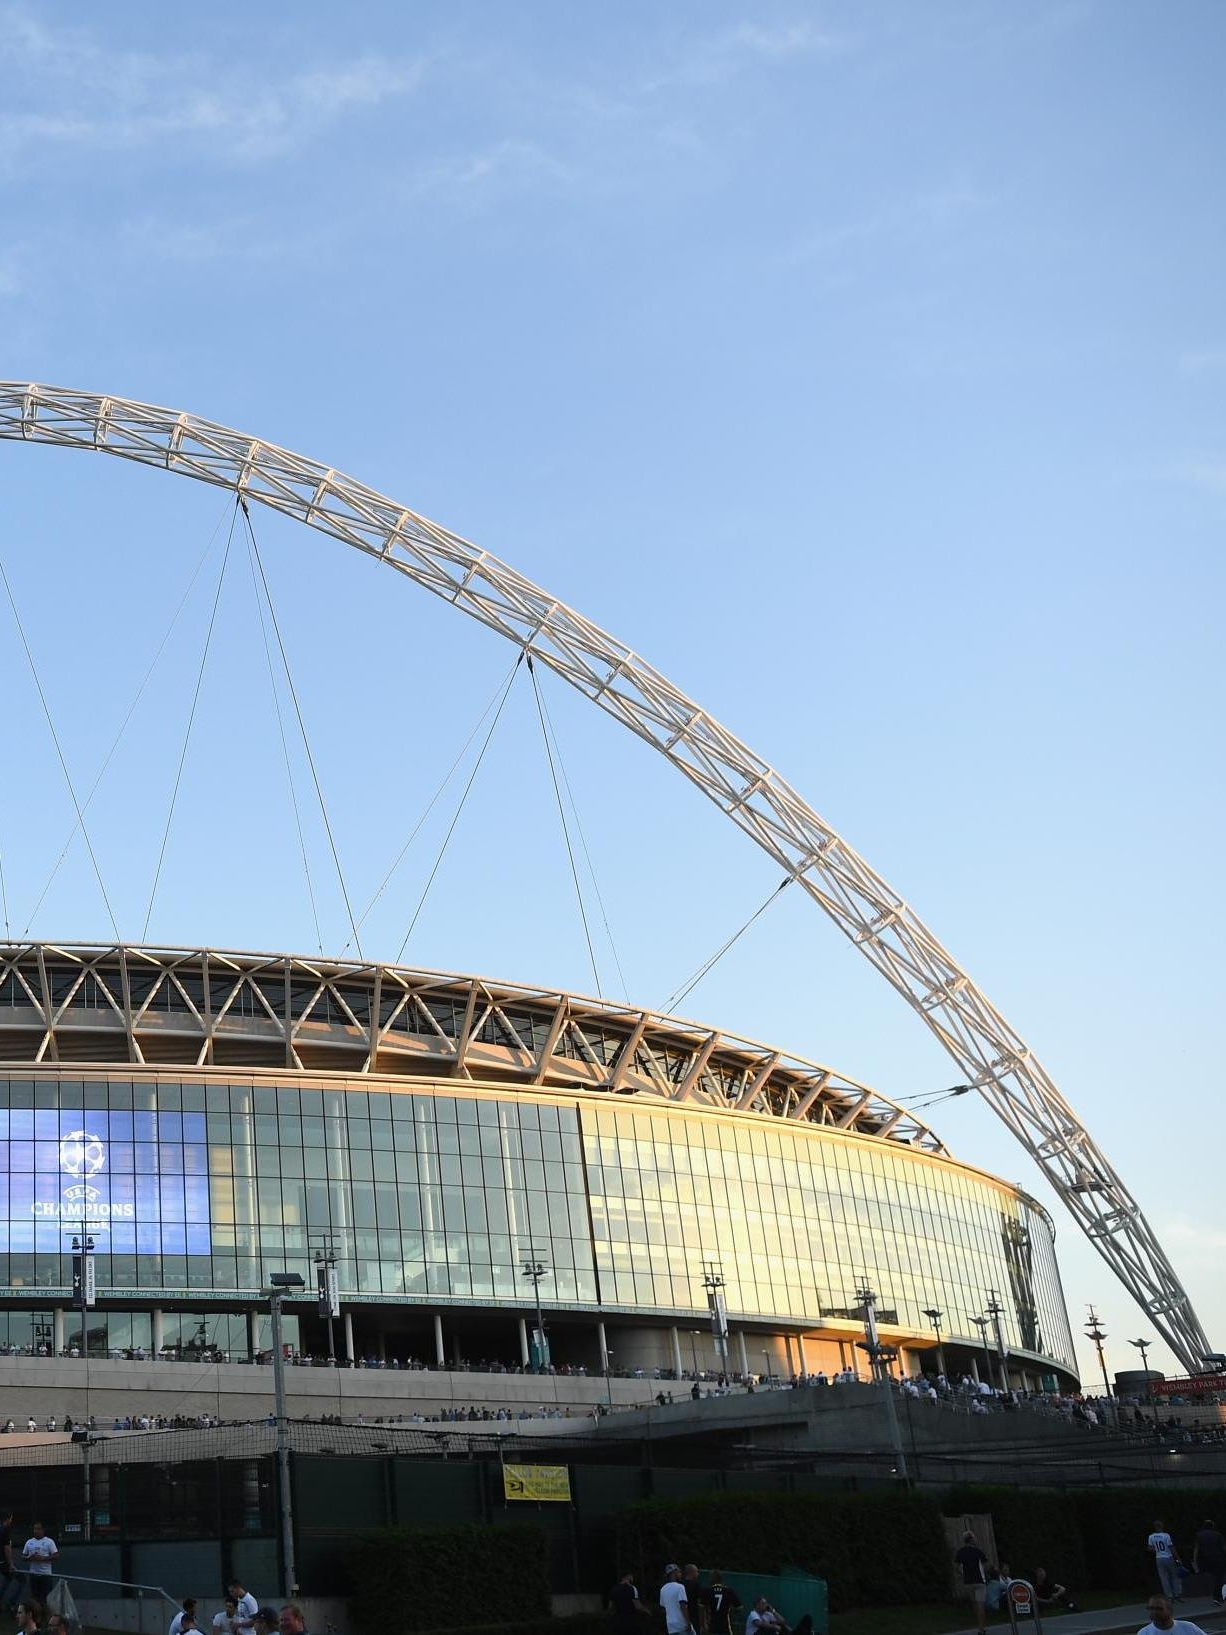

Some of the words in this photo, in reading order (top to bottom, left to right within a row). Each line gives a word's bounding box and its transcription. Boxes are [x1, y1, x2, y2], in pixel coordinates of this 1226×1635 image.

[31, 1202, 134, 1217] CHAMPIONS
[1160, 1382, 1197, 1391] WEMBLEY
[1198, 1380, 1218, 1388] PARK
[1155, 1540, 1165, 1551] 10
[714, 1594, 723, 1611] 7
